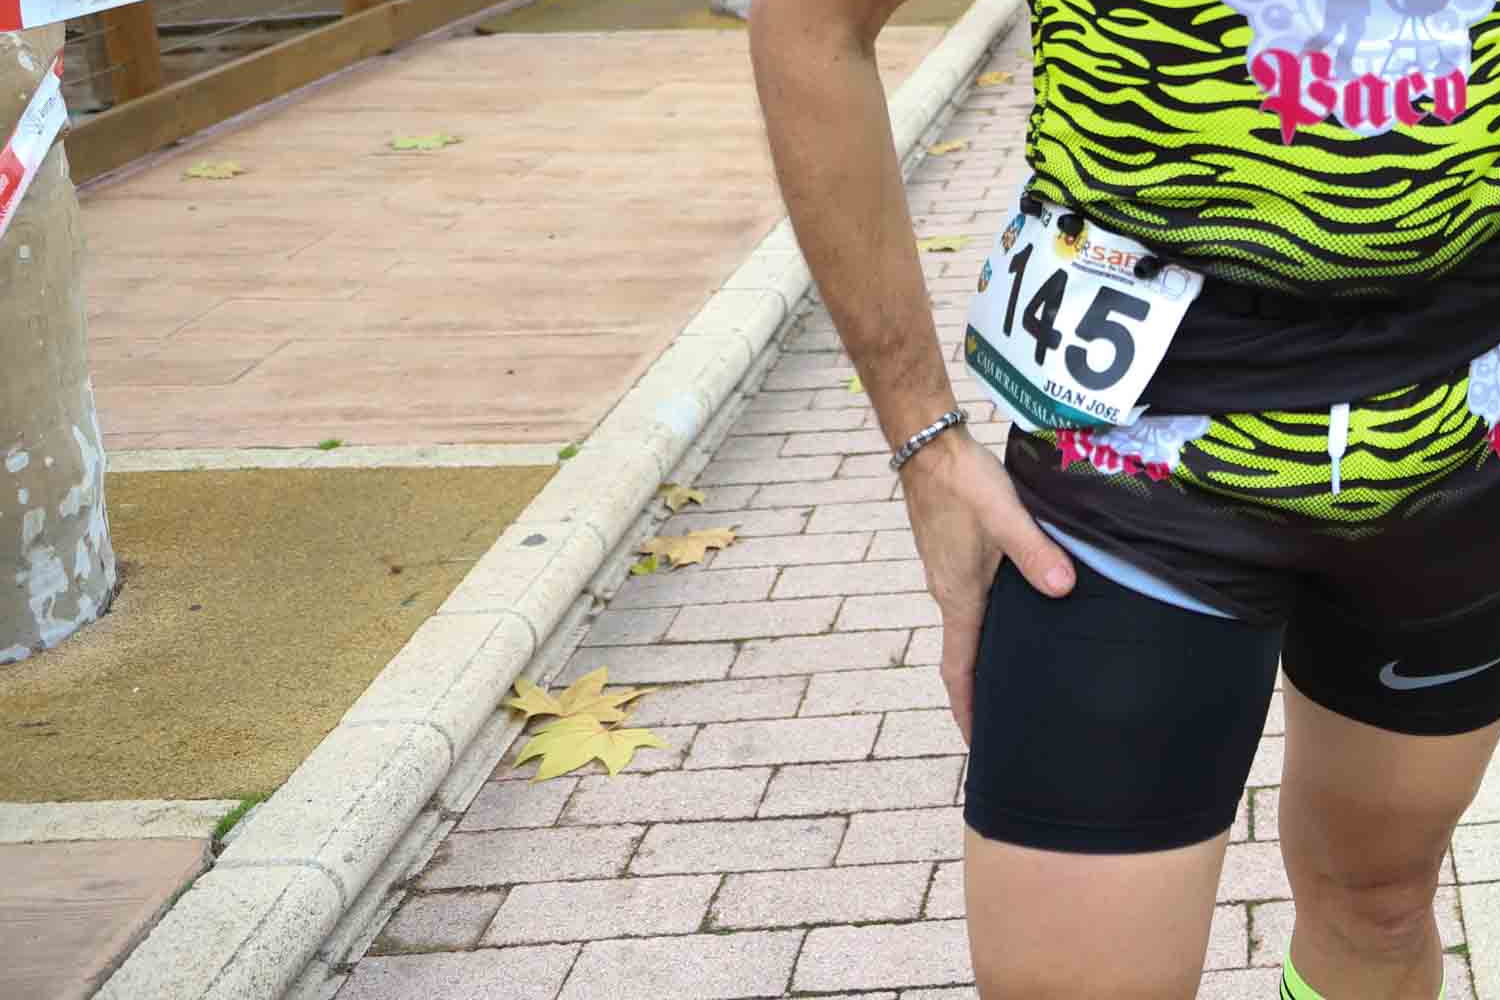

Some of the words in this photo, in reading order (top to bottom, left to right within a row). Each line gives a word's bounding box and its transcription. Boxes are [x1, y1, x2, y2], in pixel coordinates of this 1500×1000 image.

[1250, 47, 1468, 147] Paco
[1002, 242, 1151, 391] 145
[1043, 379, 1087, 406] JUAN
[1086, 400, 1120, 422] JOSE
